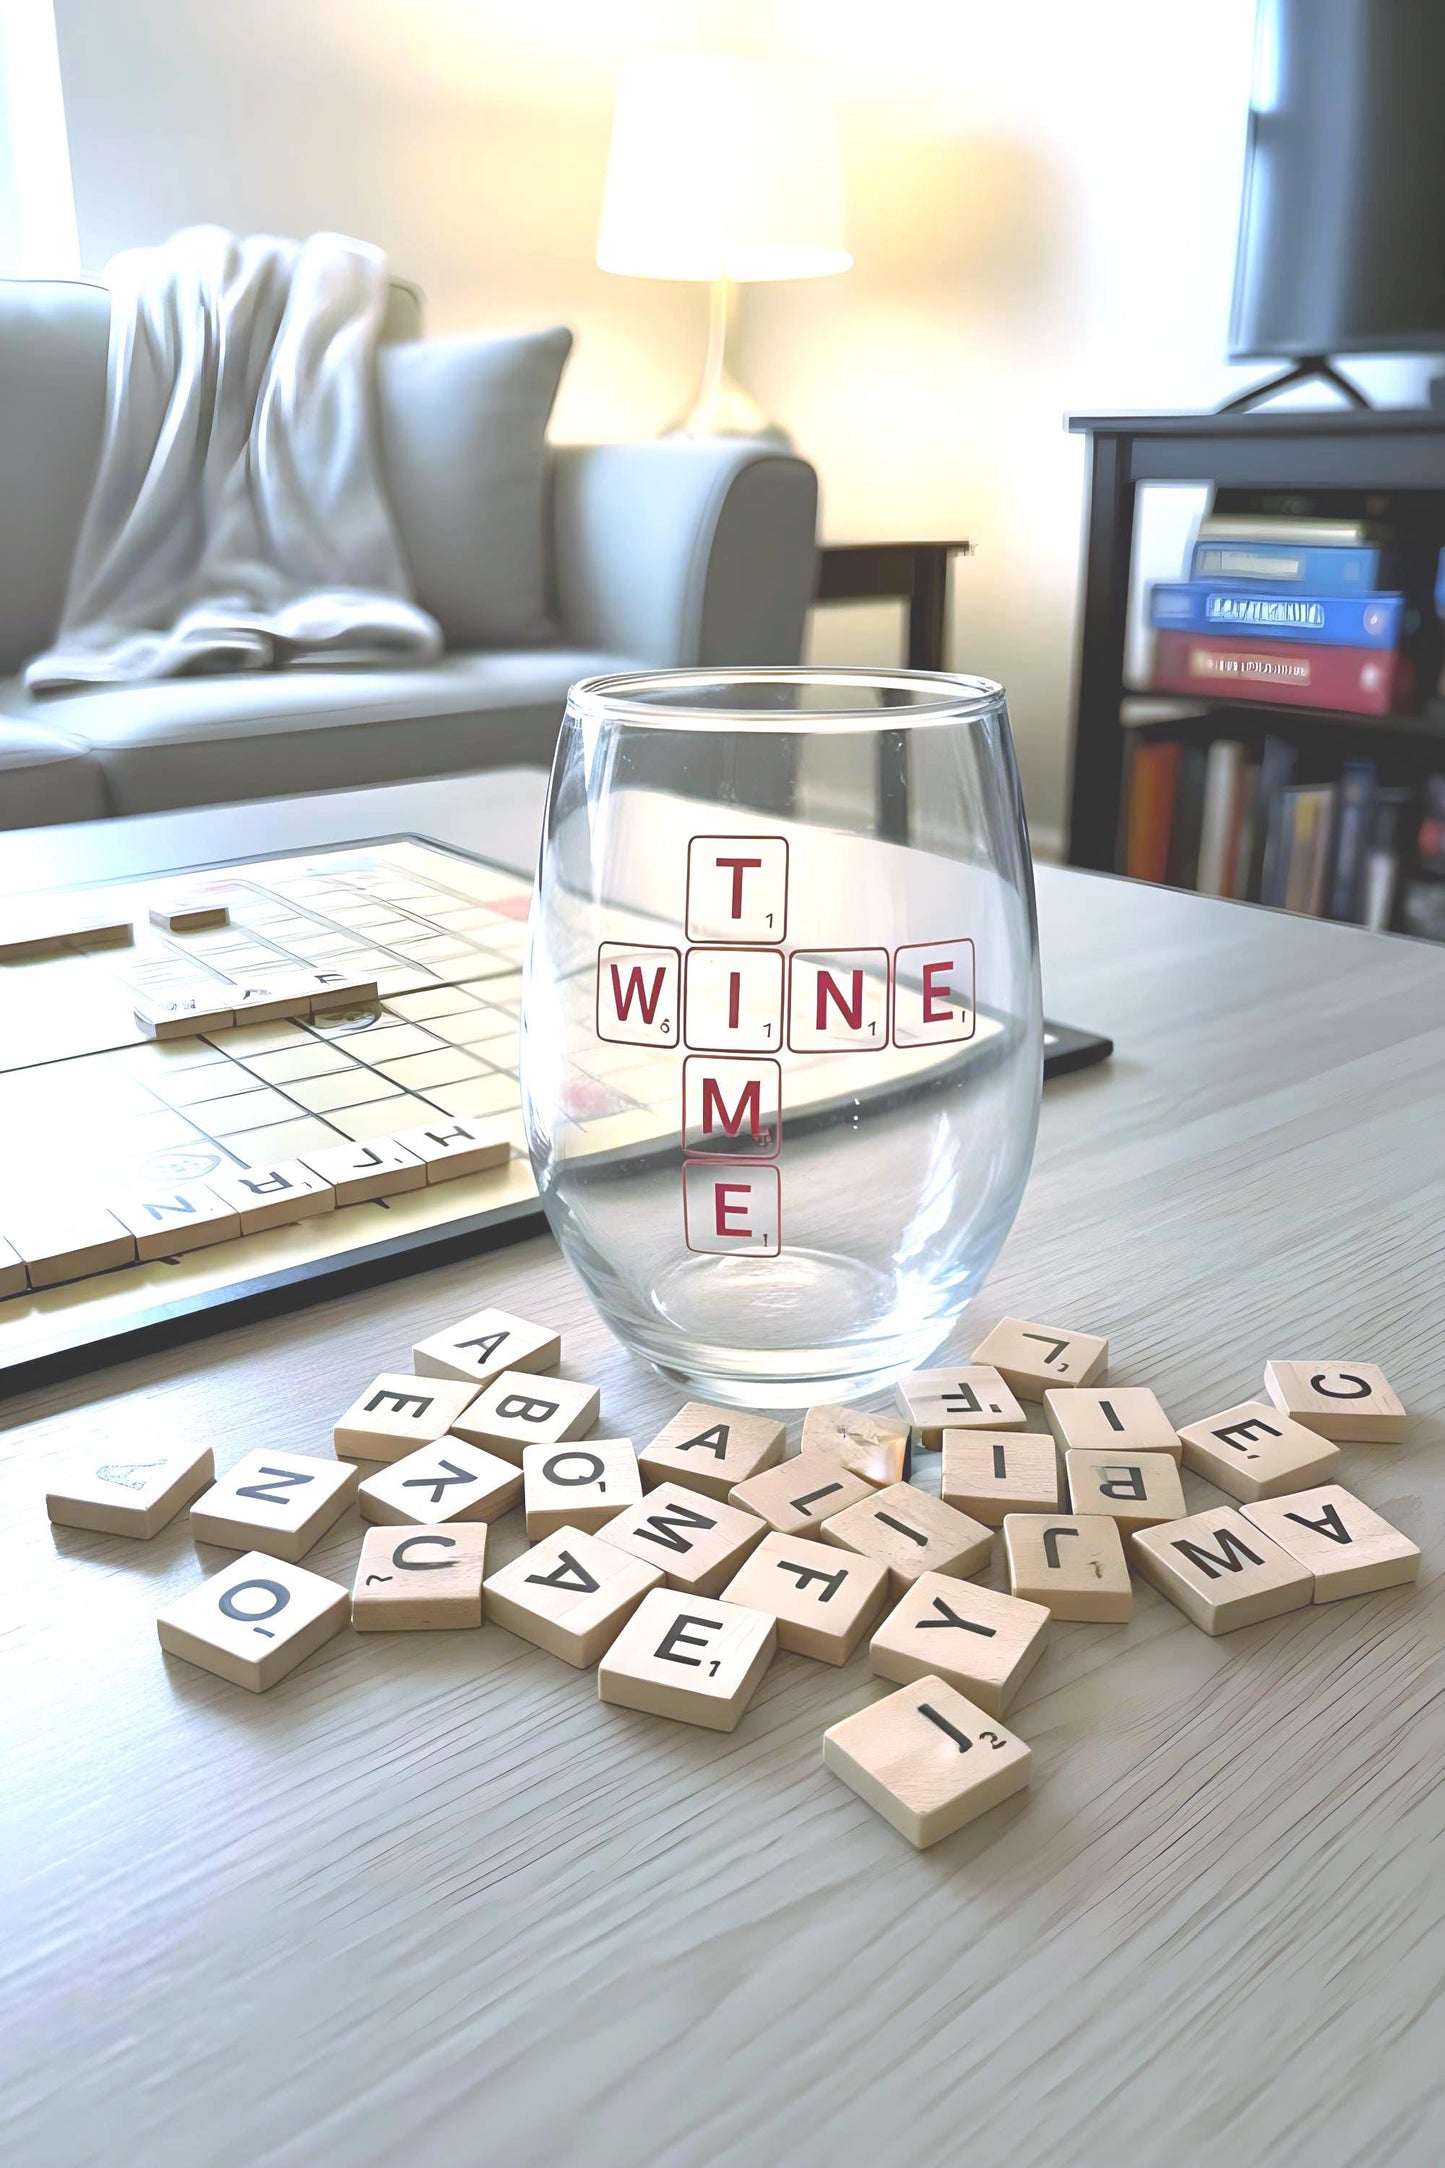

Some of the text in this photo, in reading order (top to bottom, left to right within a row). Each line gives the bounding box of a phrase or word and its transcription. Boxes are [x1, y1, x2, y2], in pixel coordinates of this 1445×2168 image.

[453, 1331, 511, 1365] A
[363, 1389, 435, 1419] E
[1310, 1373, 1373, 1400] C
[674, 1423, 731, 1461] A
[1210, 1418, 1284, 1452] E
[235, 1466, 315, 1505] N
[1282, 1503, 1353, 1545] A
[523, 1550, 601, 1594] A
[218, 1578, 291, 1622] O
[914, 1596, 997, 1638] Y
[653, 1613, 724, 1667] E
